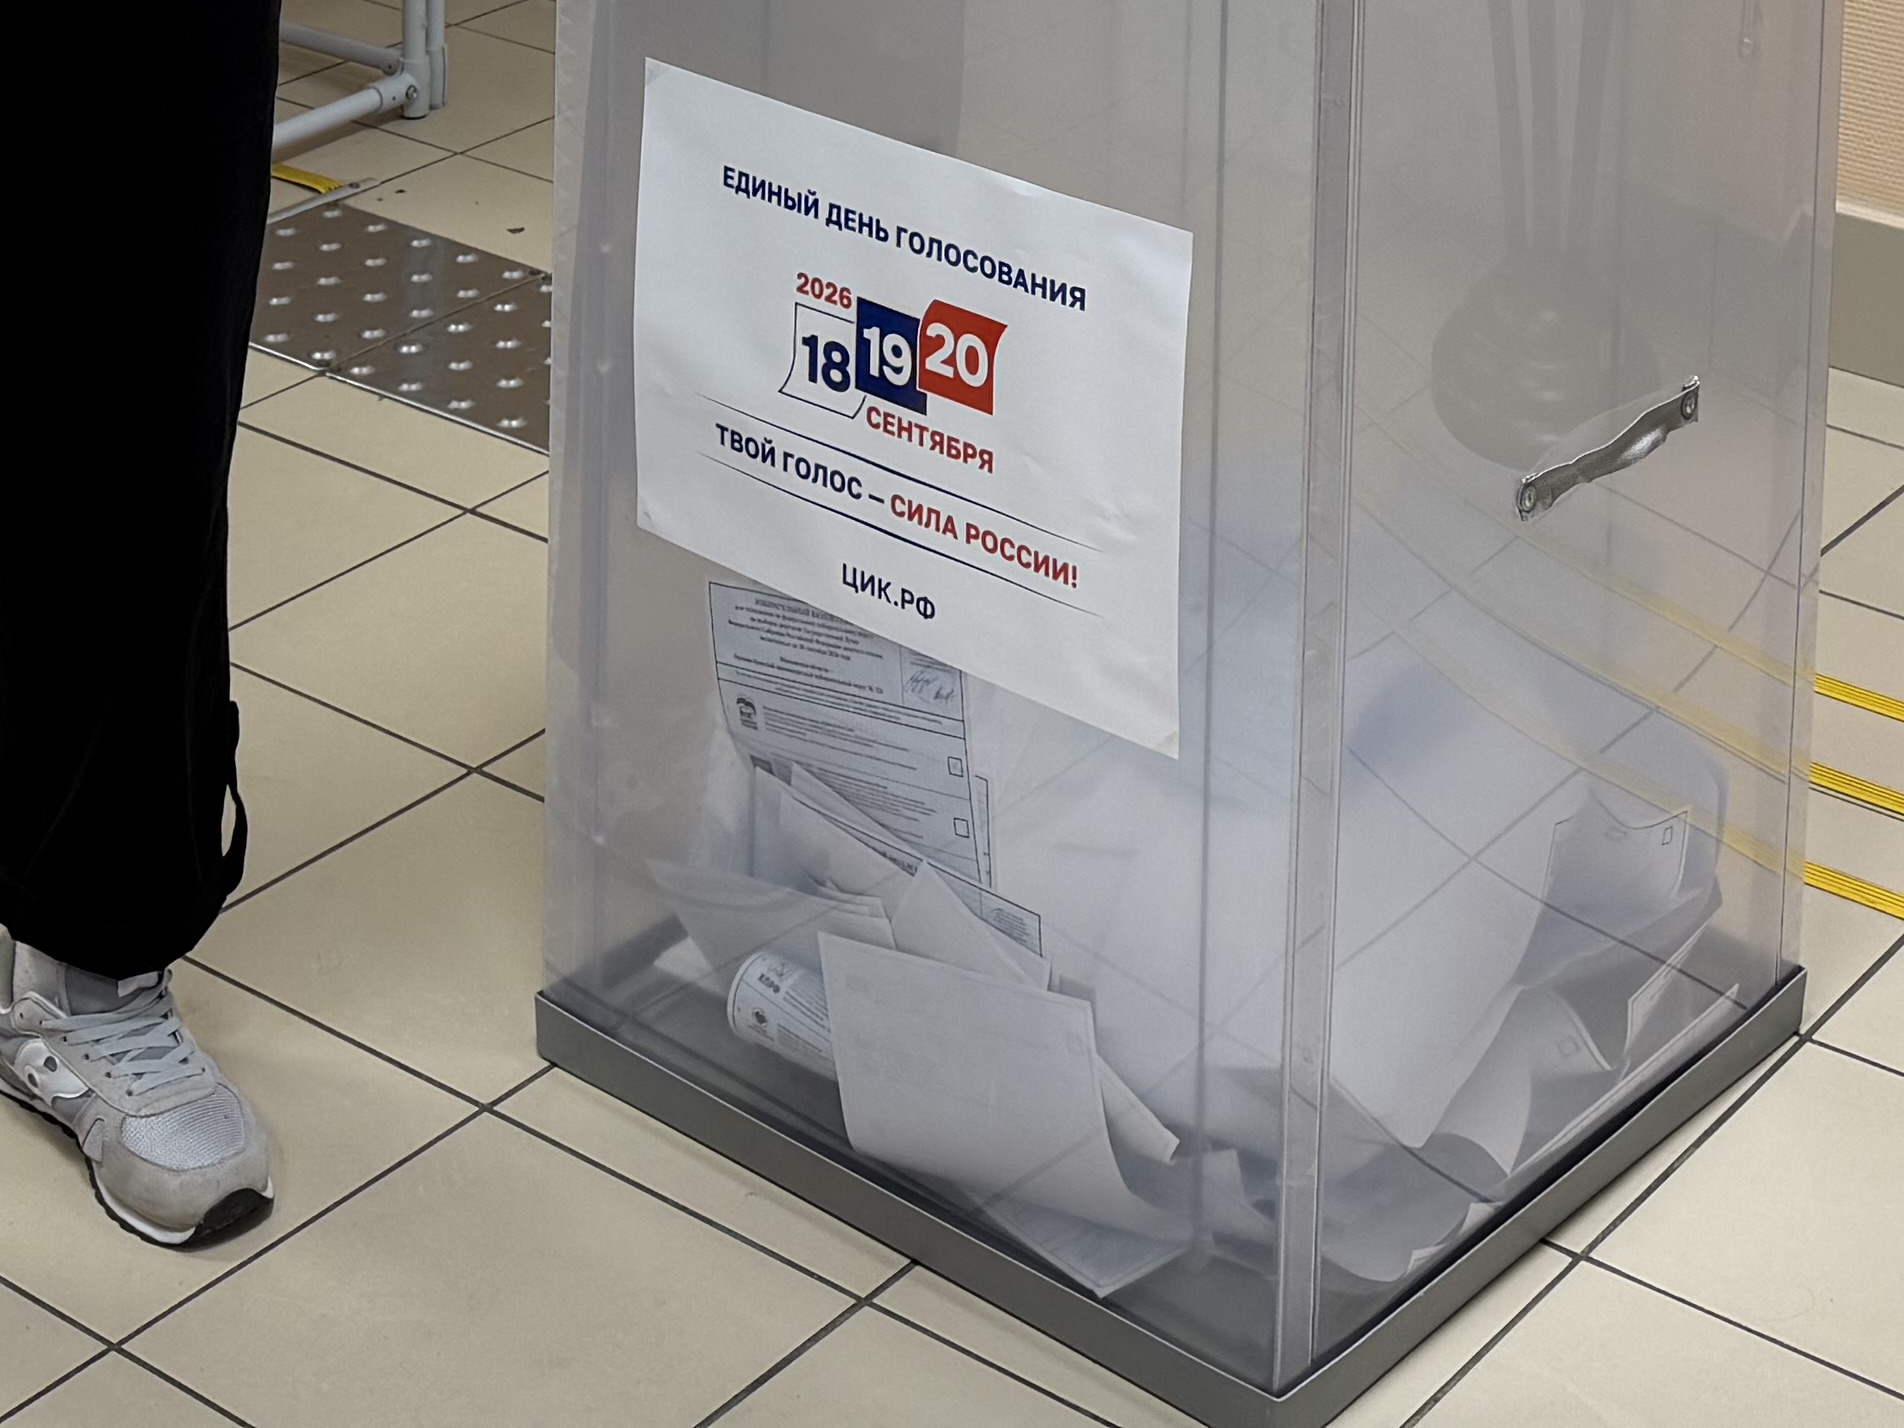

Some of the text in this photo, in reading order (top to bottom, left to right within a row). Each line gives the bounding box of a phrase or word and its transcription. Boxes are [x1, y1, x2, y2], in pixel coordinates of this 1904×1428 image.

[723, 165, 1087, 312] ЕДИНЫЙ ДЕНЬ ГОЛОСОВАНИЯ
[796, 272, 853, 310] 2026
[801, 322, 989, 393] 18 19 20
[866, 405, 994, 474] СЕНТЯБРЯ
[715, 423, 776, 468] ТВОЙ
[783, 452, 863, 501] ГОЛОС
[890, 494, 959, 541] СИЛА
[965, 522, 1079, 589] РОССИИ!
[842, 563, 936, 620] ЦИК.РФ
